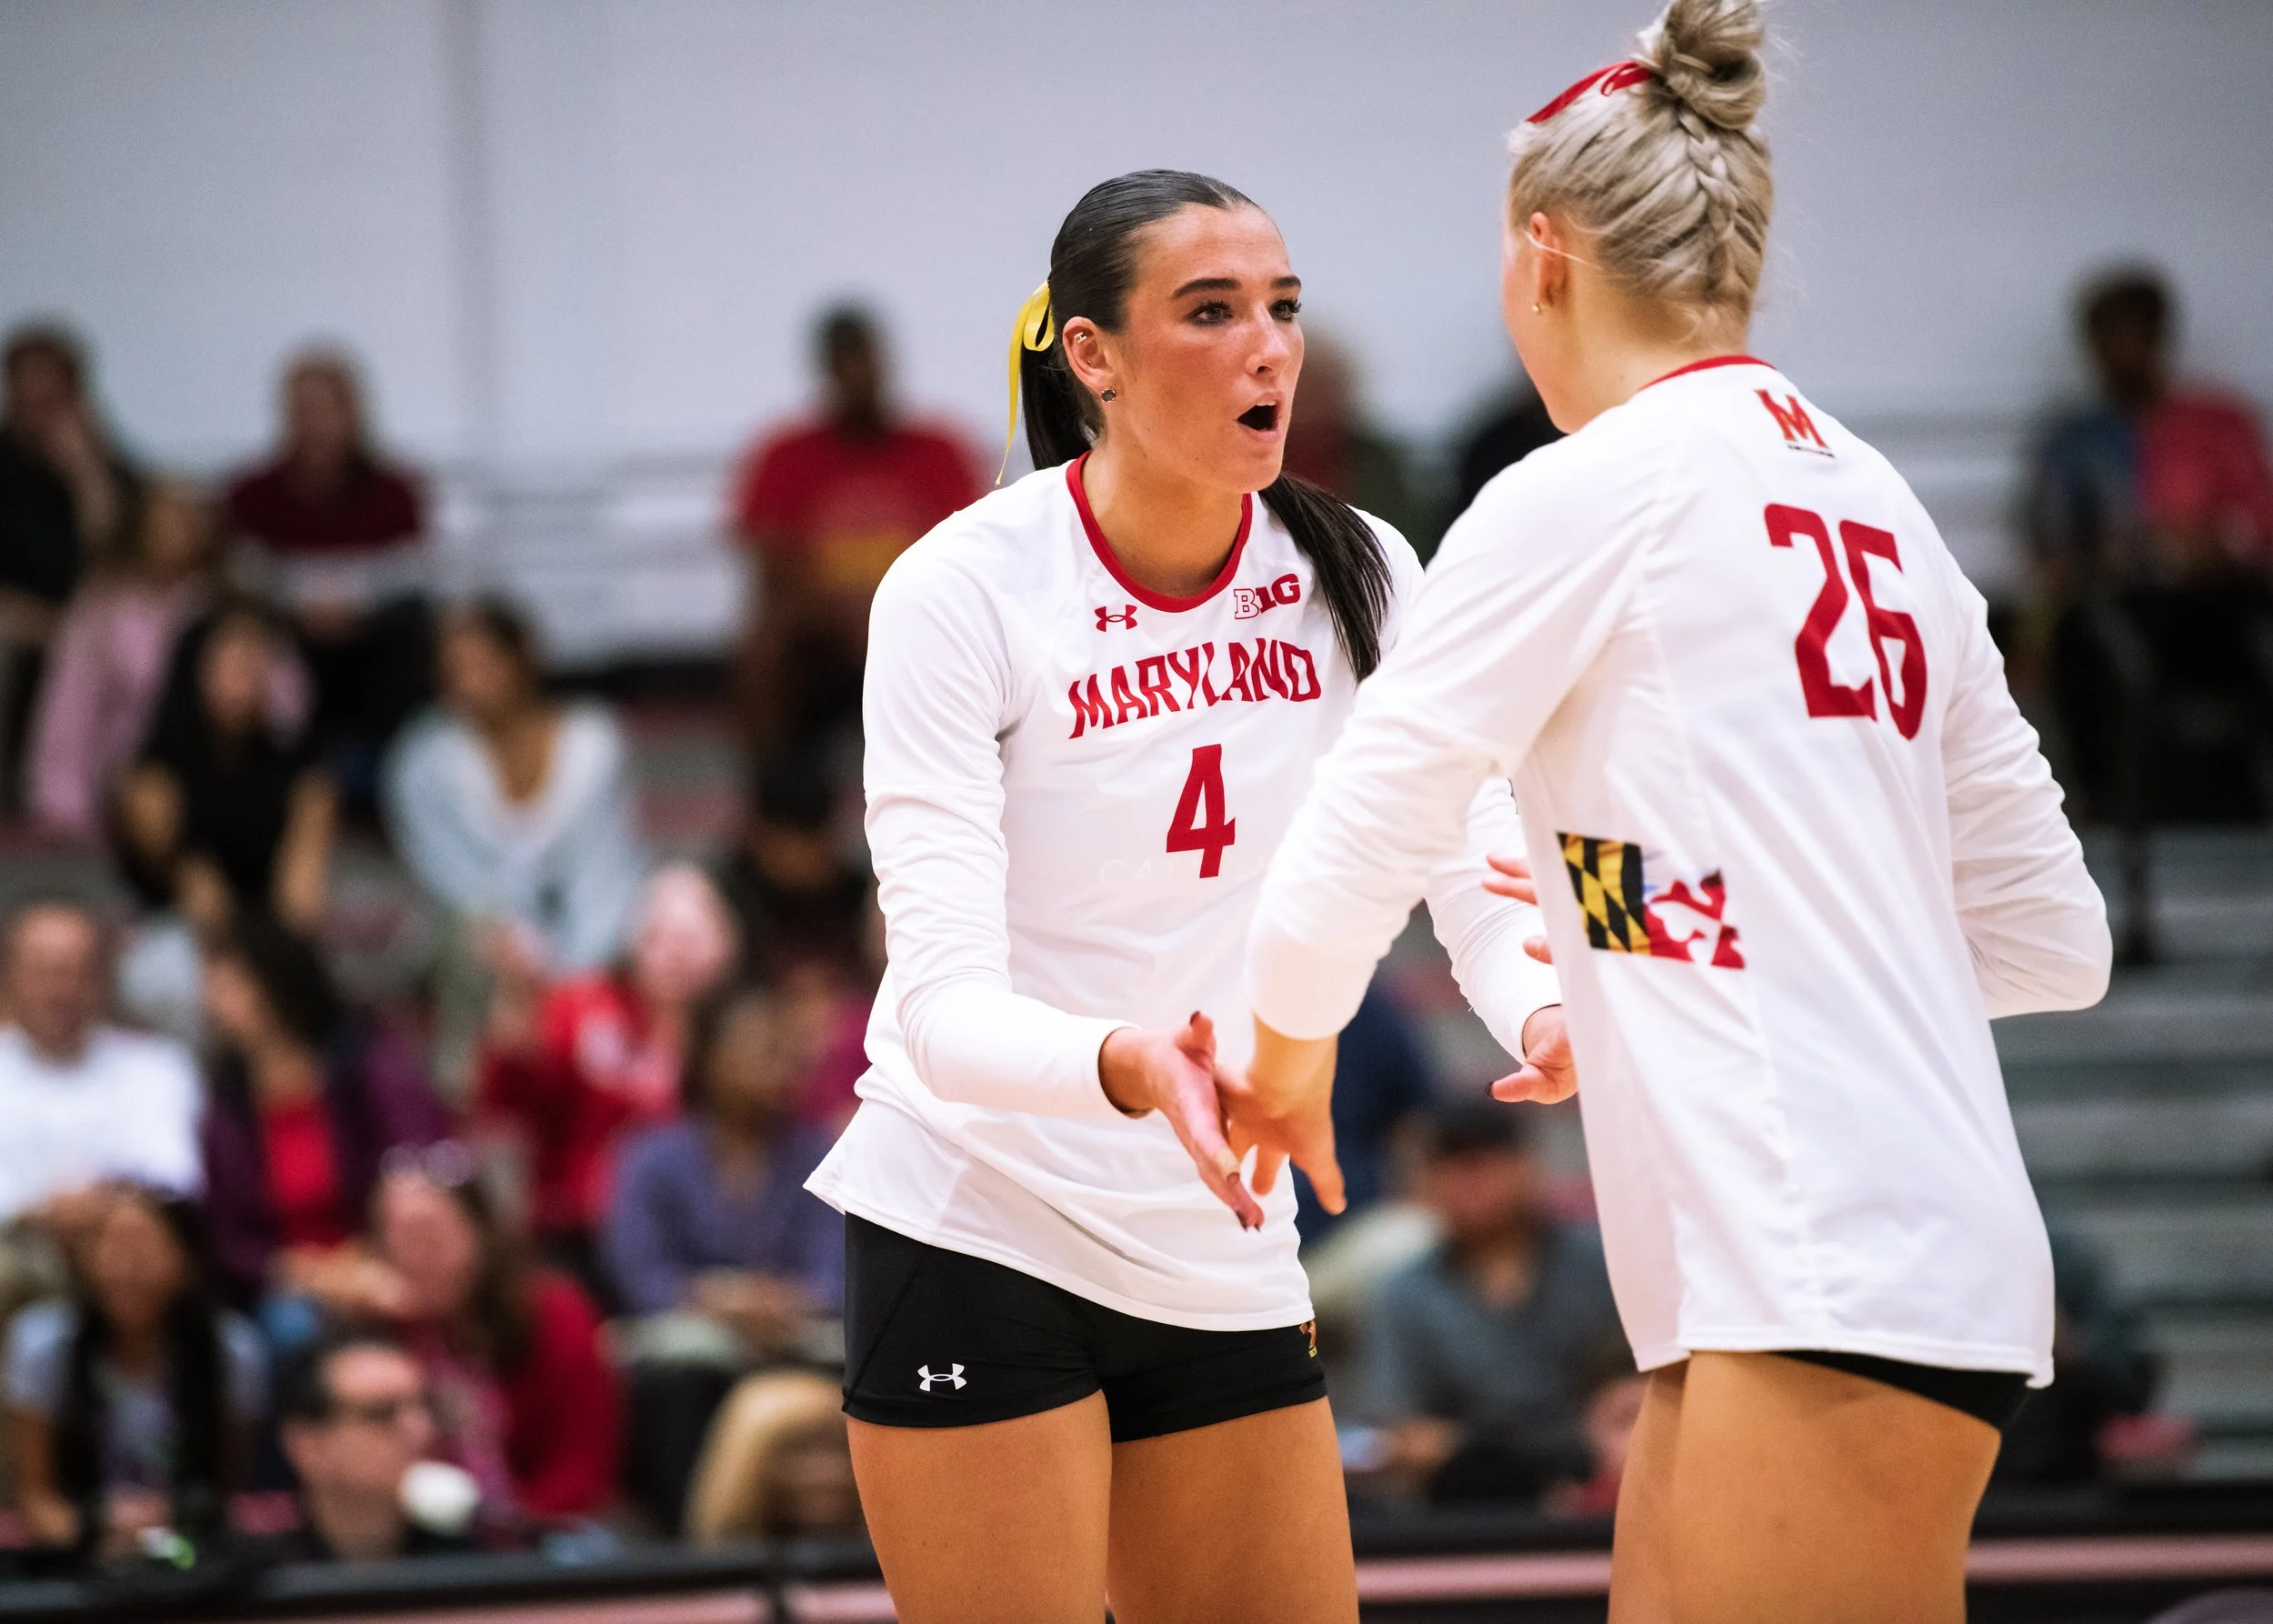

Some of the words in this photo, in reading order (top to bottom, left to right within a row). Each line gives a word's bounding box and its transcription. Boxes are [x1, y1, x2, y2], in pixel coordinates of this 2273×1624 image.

[1753, 388, 1830, 450] M
[1764, 502, 1928, 741] 26
[1068, 637, 1322, 740] MARYLAND
[1167, 744, 1236, 879] 4
